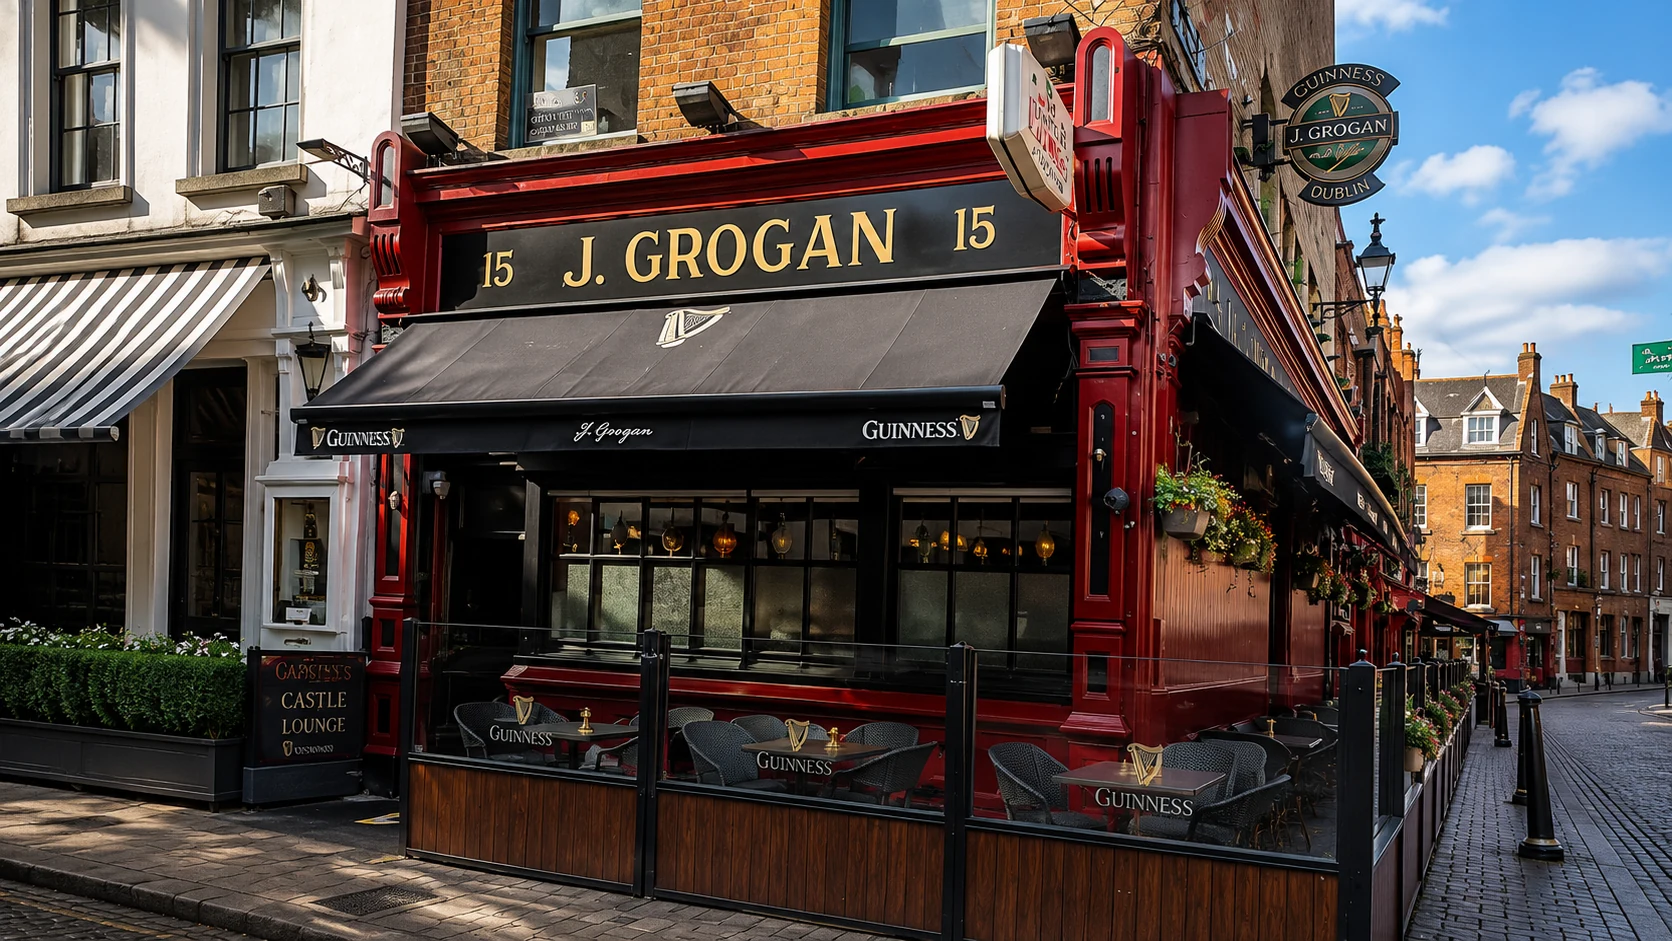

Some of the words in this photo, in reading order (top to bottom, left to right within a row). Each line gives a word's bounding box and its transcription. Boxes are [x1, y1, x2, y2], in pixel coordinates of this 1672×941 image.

[1293, 67, 1386, 98] GUINNESS
[1290, 128, 1304, 144] J.
[1308, 118, 1388, 140] GROGAN
[1310, 178, 1371, 200] DUBLIN
[953, 204, 997, 251] 15
[562, 236, 606, 287] J.
[625, 208, 897, 283] GROGAN
[481, 249, 515, 288] 15
[326, 428, 392, 447] GUINNESS
[861, 419, 958, 440] GUINNESS
[281, 691, 347, 710] CASTLE
[281, 717, 346, 735] LOUNGE
[489, 724, 553, 747] GUINNESS
[756, 750, 832, 776] GUINNESS
[1095, 787, 1194, 817] GUINNESS
